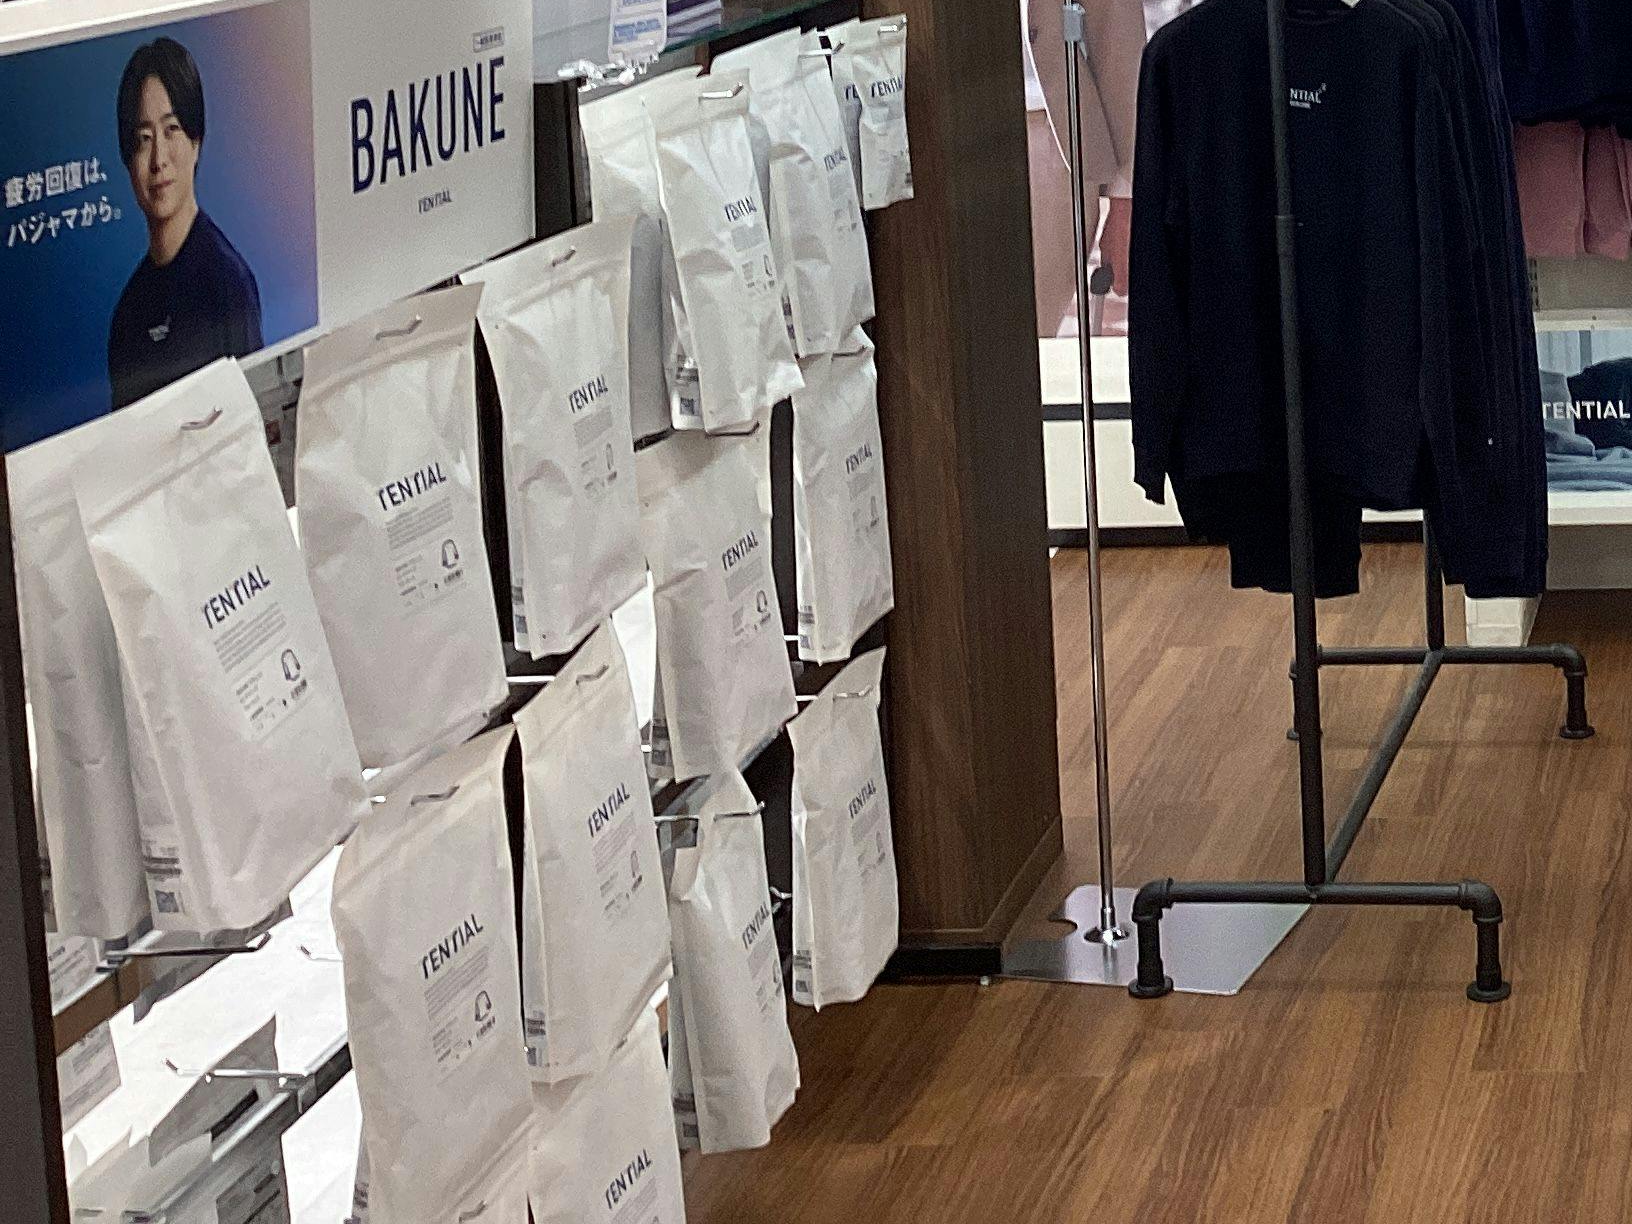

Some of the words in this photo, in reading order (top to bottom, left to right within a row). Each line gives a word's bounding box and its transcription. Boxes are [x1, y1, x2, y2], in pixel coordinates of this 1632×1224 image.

[1290, 88, 1321, 104] NTIAL
[351, 56, 505, 194] BAKUNE
[5, 156, 107, 209] 疲労回復は、
[418, 191, 452, 214] TENTIAL
[8, 195, 122, 248] パジャマから。
[724, 196, 758, 223] TENTIAL
[569, 374, 609, 414] TENTIAL
[1543, 399, 1631, 421] TENTIAL
[845, 443, 873, 474] TENTIAL
[378, 462, 447, 512] TENTIAL
[721, 529, 760, 572] TENTIAL
[202, 564, 271, 630] TENTIAL
[588, 782, 631, 838] TENTIAL
[847, 778, 878, 820] TENTIAL
[421, 912, 484, 981] TENTIAL
[741, 898, 770, 951] TENTIAL
[604, 1148, 653, 1212] TENTIAL
